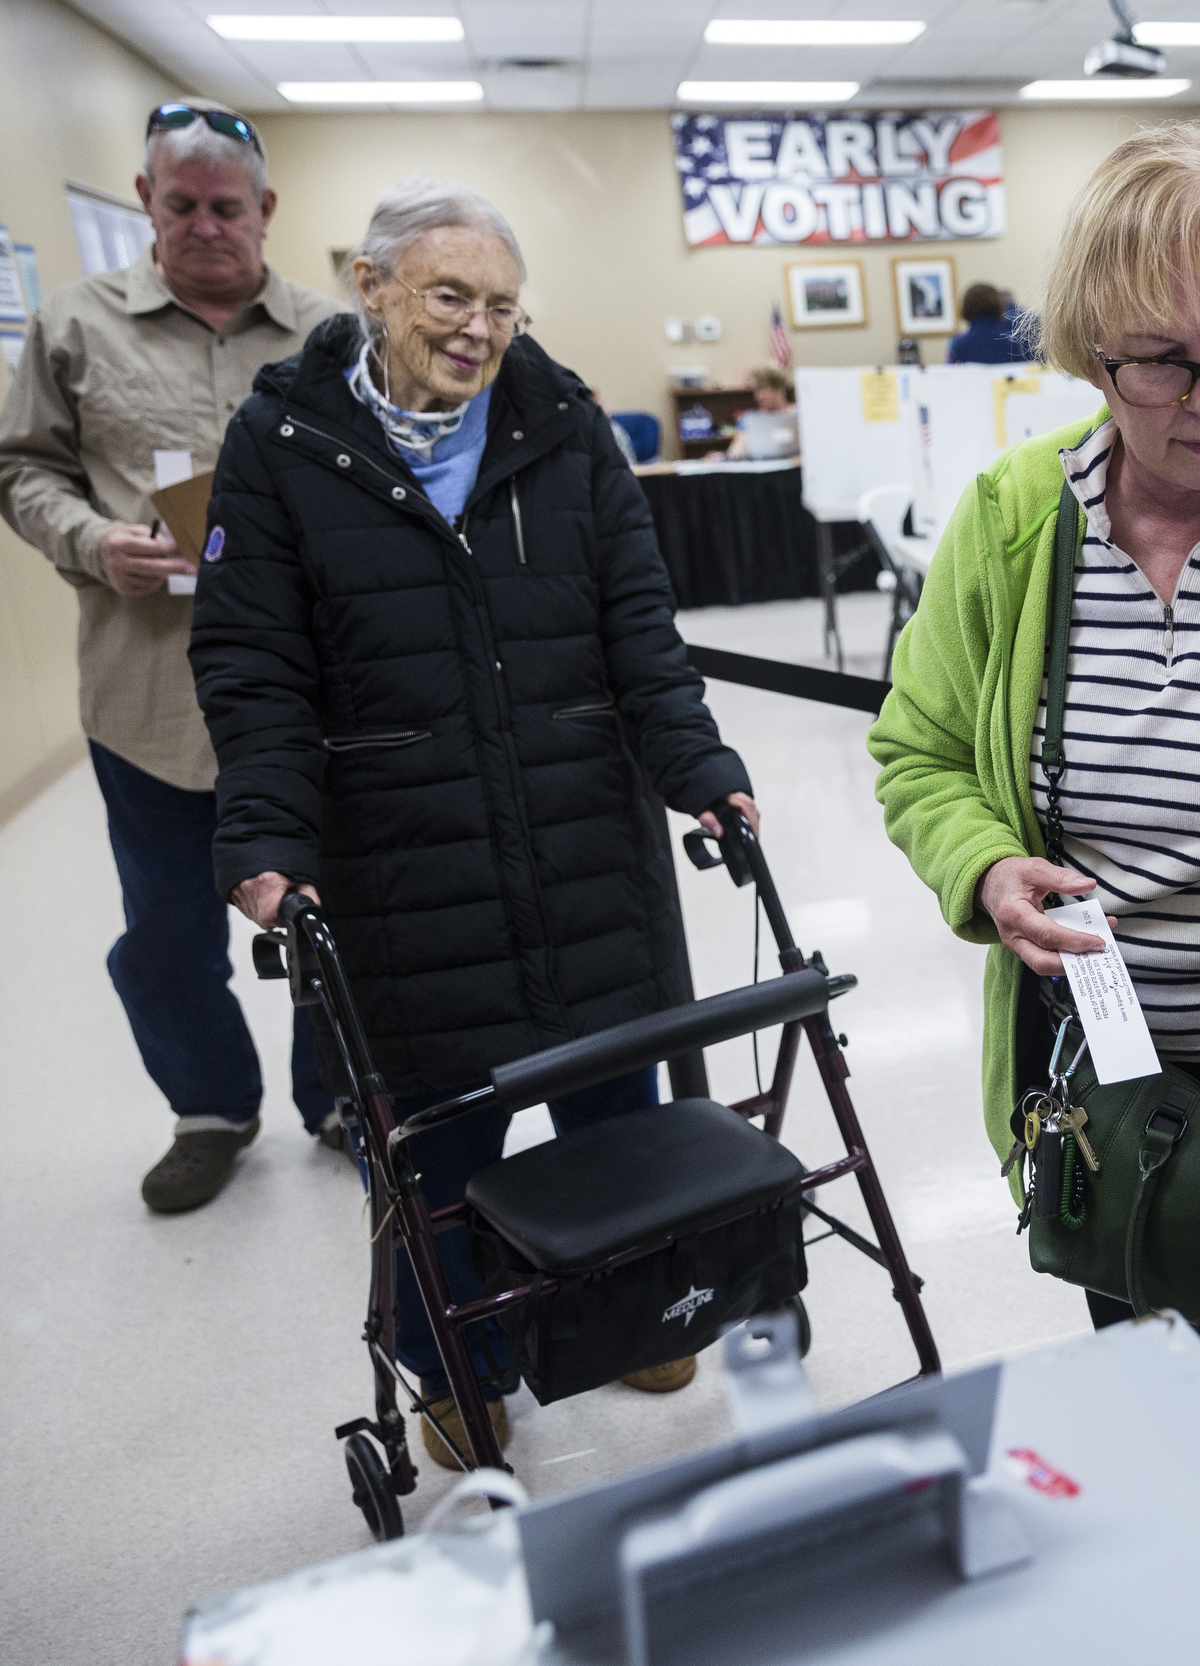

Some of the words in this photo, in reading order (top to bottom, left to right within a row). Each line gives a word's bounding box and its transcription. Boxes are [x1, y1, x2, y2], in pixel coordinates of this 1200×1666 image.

[723, 120, 962, 180] EARLY
[706, 180, 990, 243] VOTING
[1071, 964, 1080, 978] BALLOT
[1086, 959, 1095, 976] GENERAL
[1077, 978, 1086, 996] OFFICIAL
[1091, 976, 1099, 988] STATE
[1097, 972, 1108, 993] NOVEMBER
[1123, 983, 1132, 996] BALLOT
[1114, 988, 1123, 1007] Signature
[1093, 1007, 1102, 1020] STATE
[1100, 999, 1109, 1019] FEDERAL
[661, 1288, 715, 1323] MEDLINE
